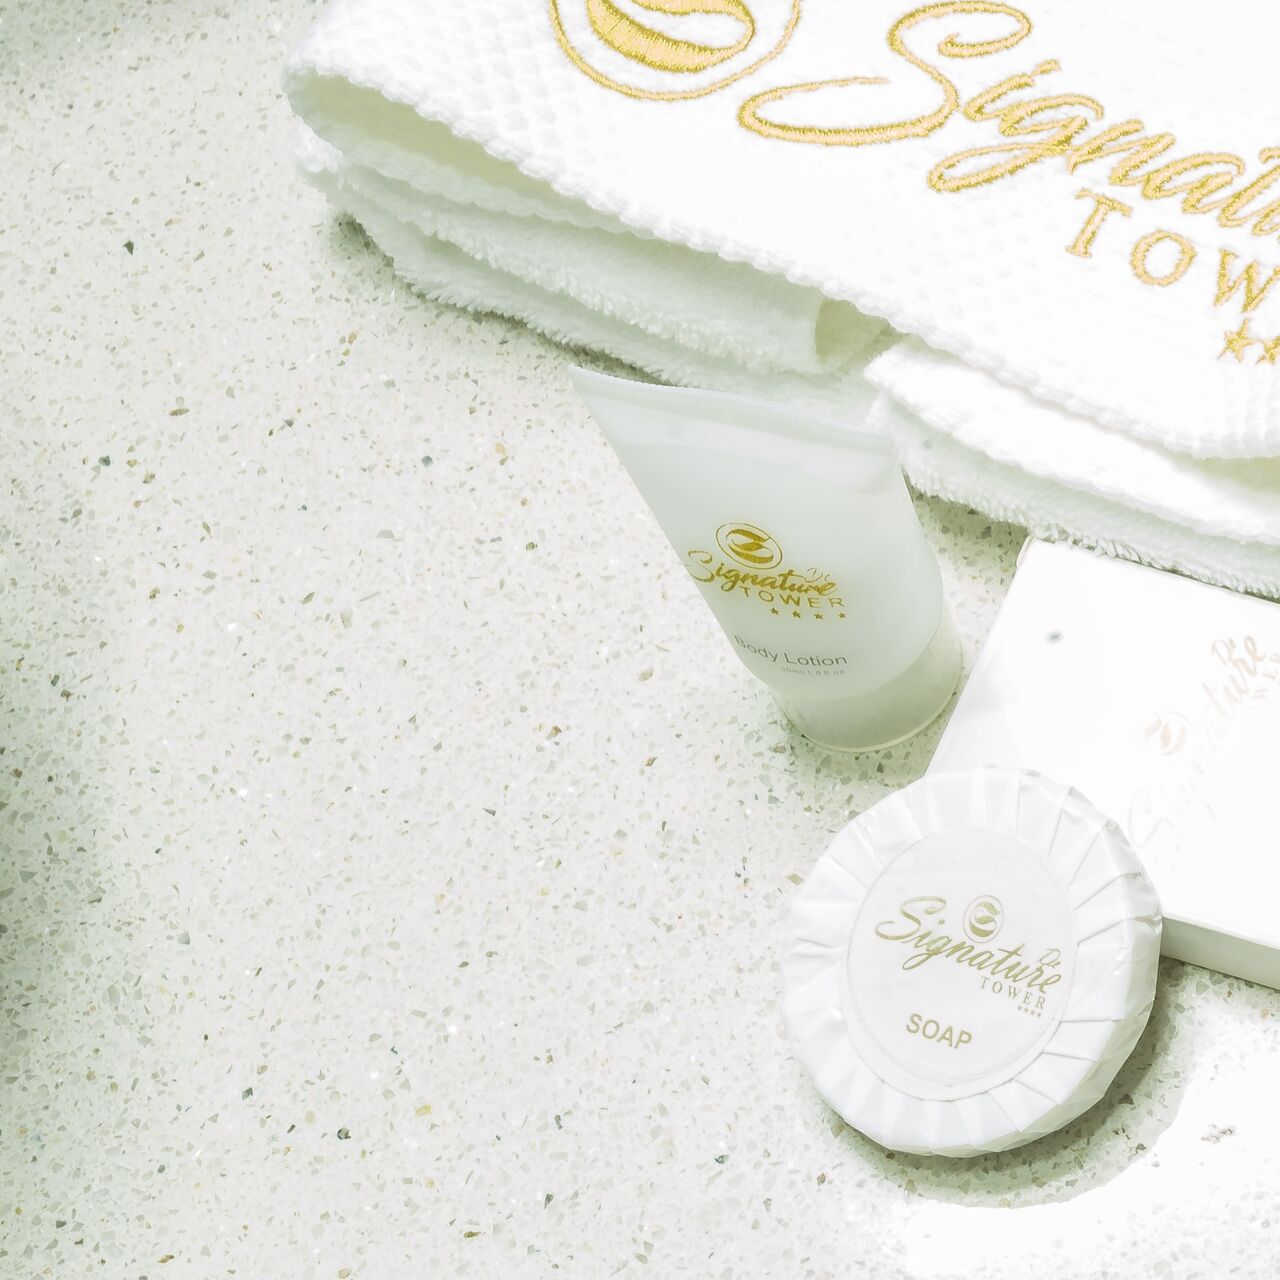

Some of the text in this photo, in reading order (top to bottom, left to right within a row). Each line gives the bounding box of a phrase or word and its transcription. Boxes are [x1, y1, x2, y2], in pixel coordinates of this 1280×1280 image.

[684, 550, 838, 596] Signature
[741, 586, 846, 609] TOWER
[734, 635, 848, 667] Body Lotion
[874, 895, 1062, 995] Signature
[979, 975, 1046, 1011] TOWER
[906, 1012, 973, 1049] SOAP
